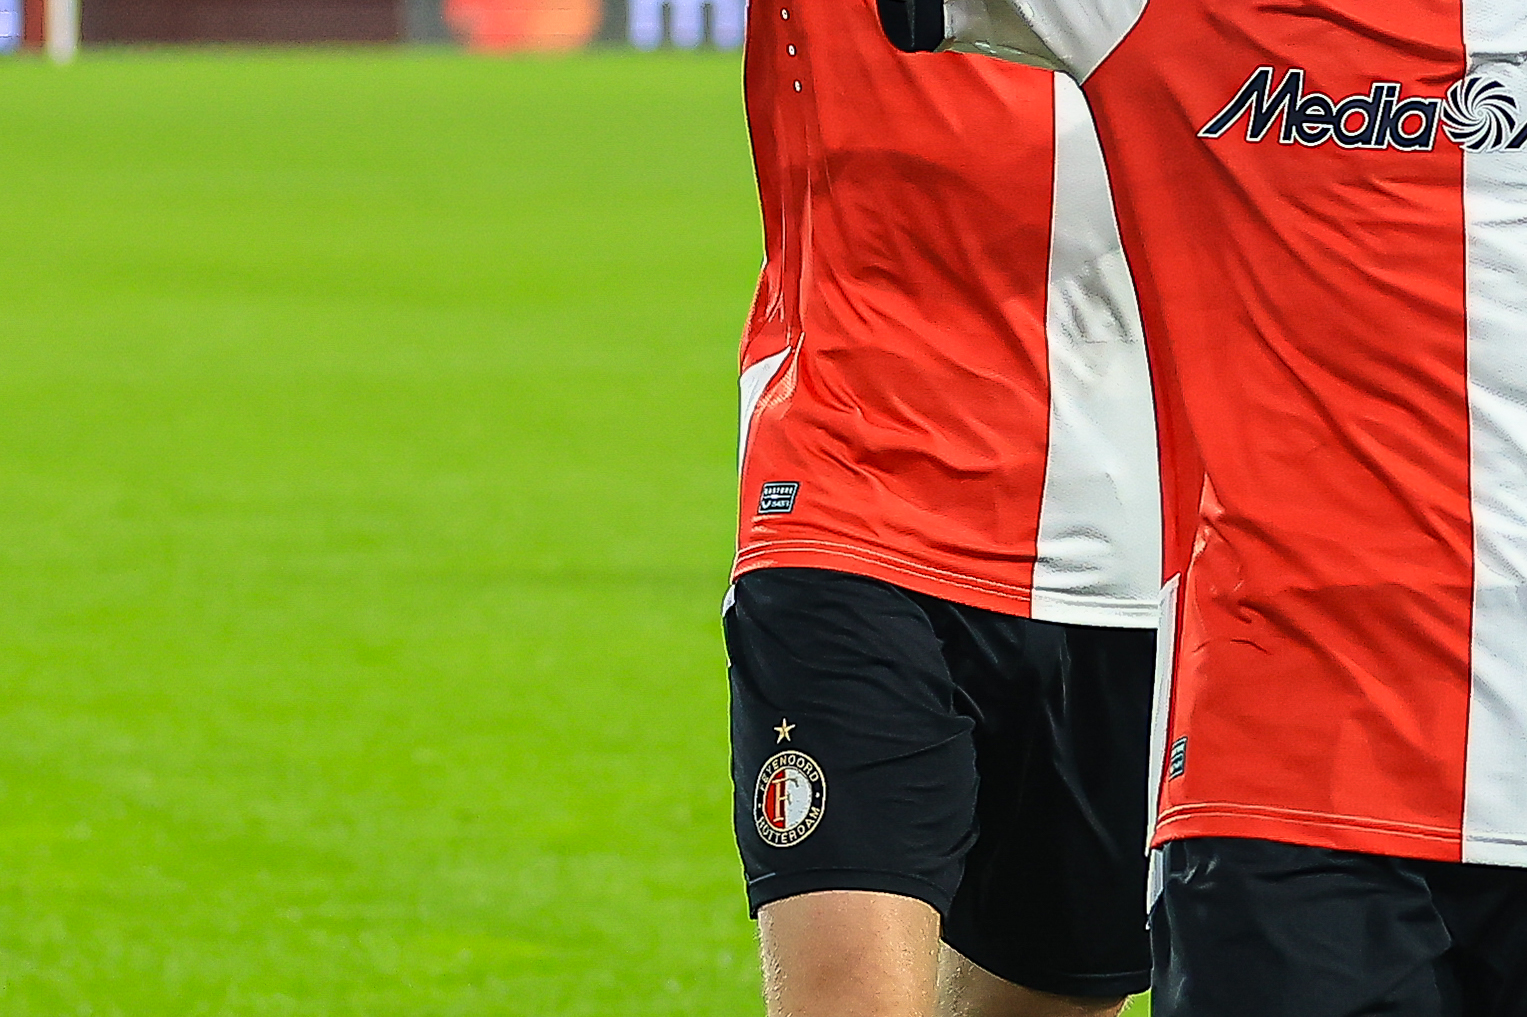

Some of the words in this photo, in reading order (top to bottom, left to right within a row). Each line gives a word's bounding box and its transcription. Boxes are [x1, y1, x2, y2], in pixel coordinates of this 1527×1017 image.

[1199, 66, 1442, 150] Media
[760, 755, 819, 792] FEYENOORD
[757, 805, 821, 844] ROTTERDAM
